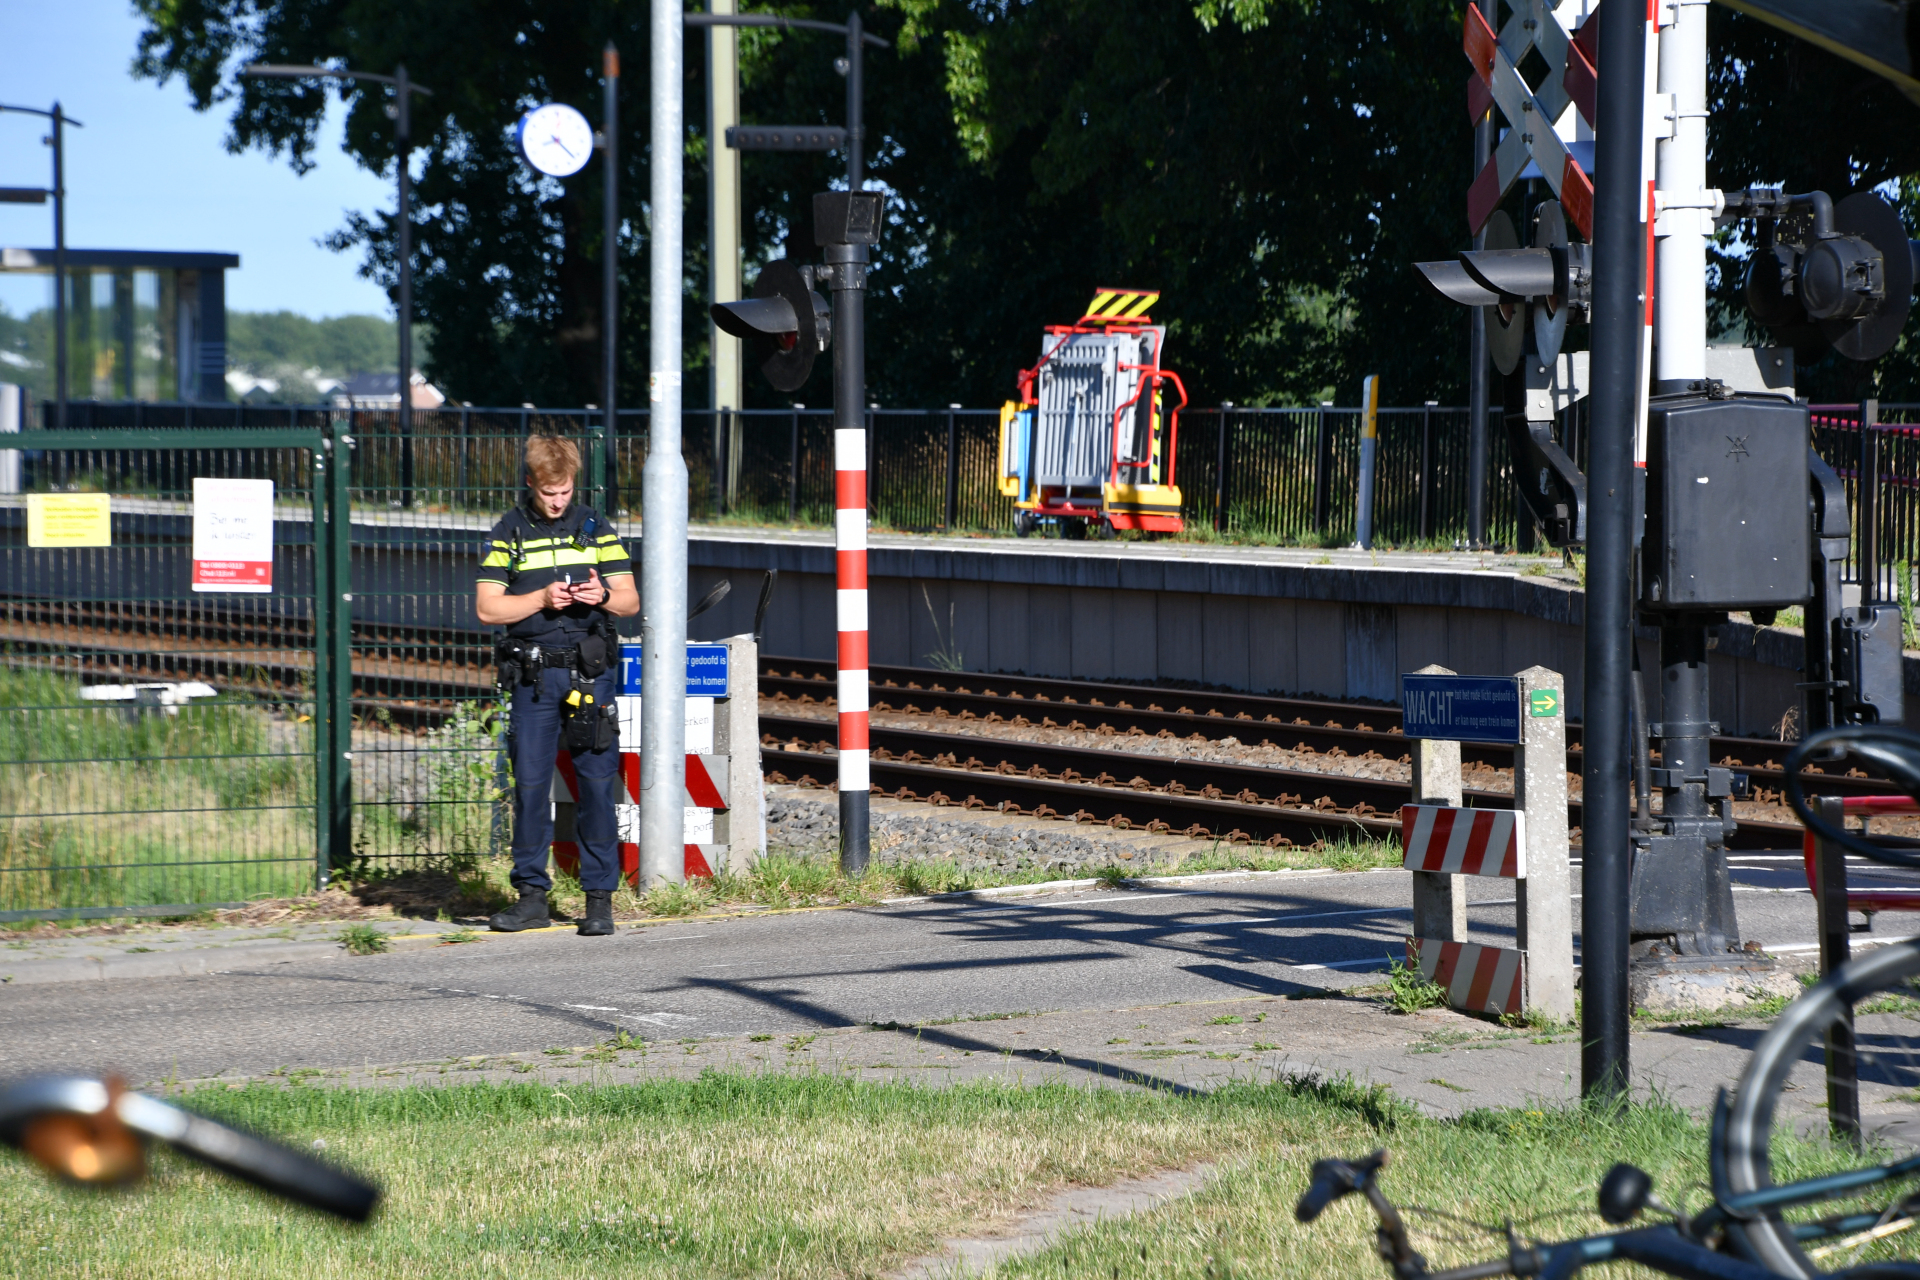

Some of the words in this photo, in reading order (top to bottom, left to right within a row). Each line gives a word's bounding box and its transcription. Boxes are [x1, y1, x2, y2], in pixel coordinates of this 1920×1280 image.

[690, 655, 718, 667] gedoofd
[720, 656, 727, 665] is
[686, 676, 701, 685] trein
[702, 676, 726, 685] komen
[1405, 690, 1454, 725] WACHT
[1454, 690, 1462, 700] tot
[1470, 690, 1480, 700] rode
[1481, 689, 1491, 701] licht
[1492, 690, 1510, 704] gedoofd
[1511, 690, 1516, 701] is
[685, 716, 709, 726] erken
[1455, 716, 1460, 725] er
[1461, 714, 1469, 726] kan
[1470, 717, 1478, 729] nog
[1479, 717, 1487, 726] een
[1488, 715, 1499, 727] trein
[1500, 715, 1516, 727] komen
[685, 746, 710, 755] erken
